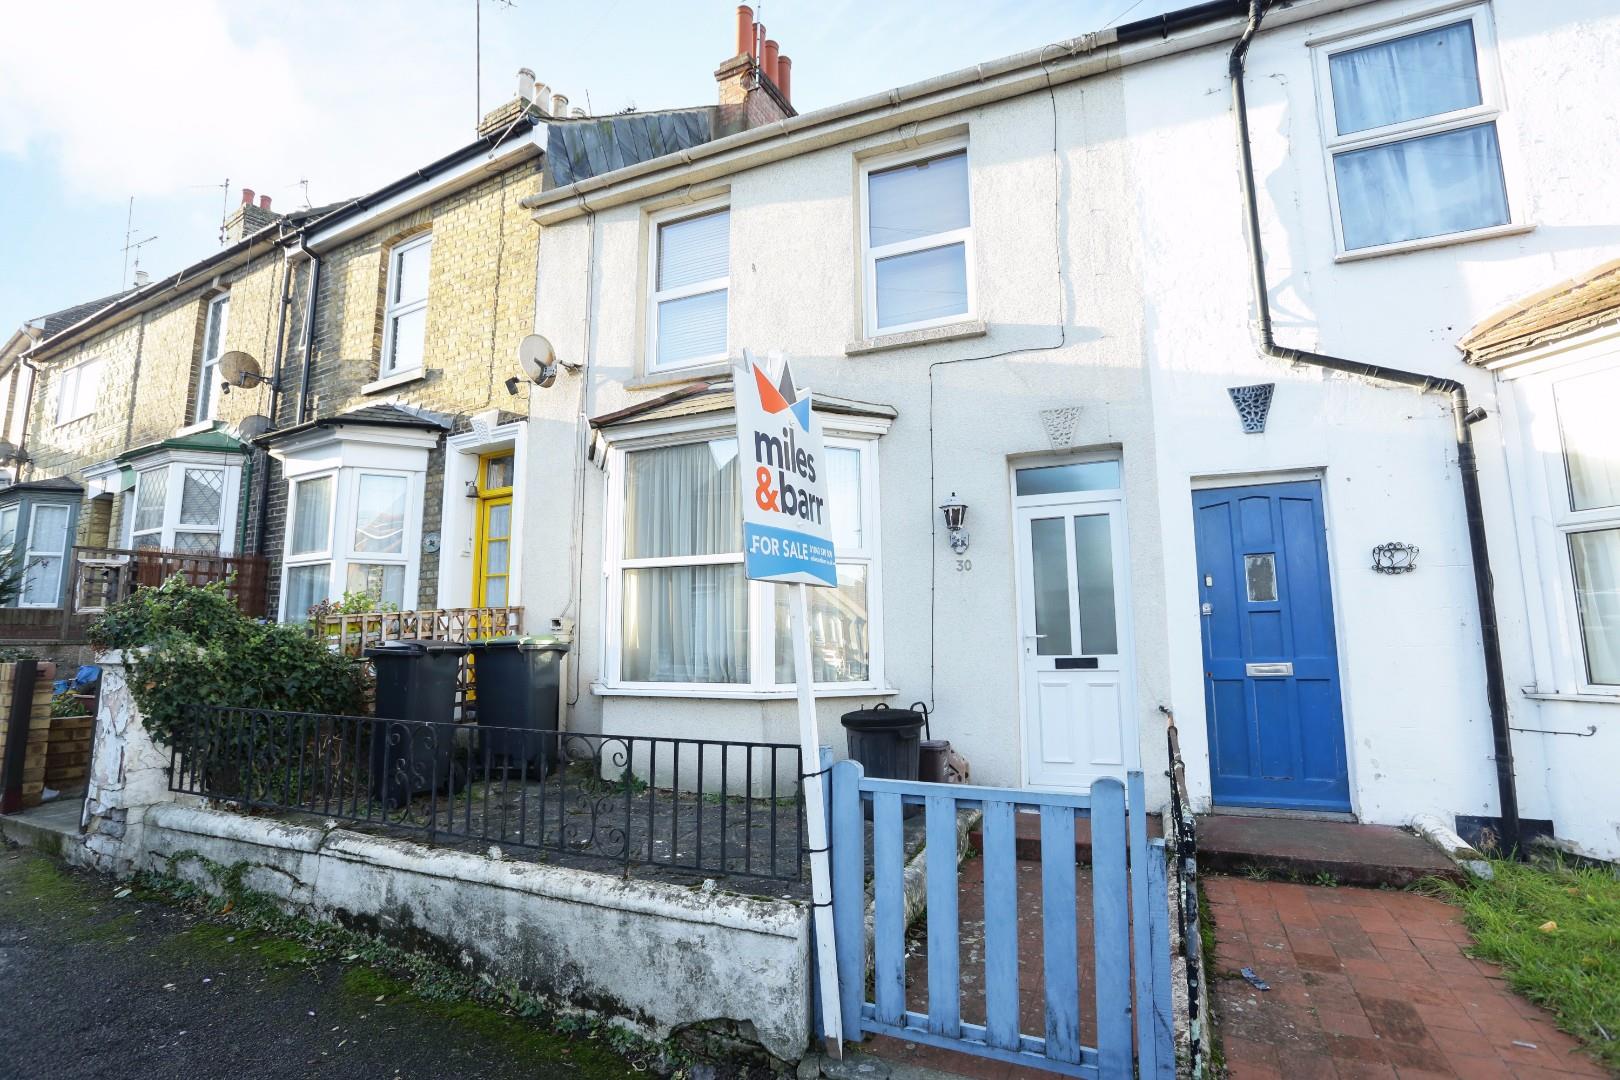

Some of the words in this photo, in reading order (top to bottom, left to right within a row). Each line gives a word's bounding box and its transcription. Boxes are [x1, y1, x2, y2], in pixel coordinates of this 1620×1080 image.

[754, 427, 816, 483] miles
[751, 535, 780, 556] FOR
[782, 539, 809, 561] SALE
[956, 559, 972, 572] 30
